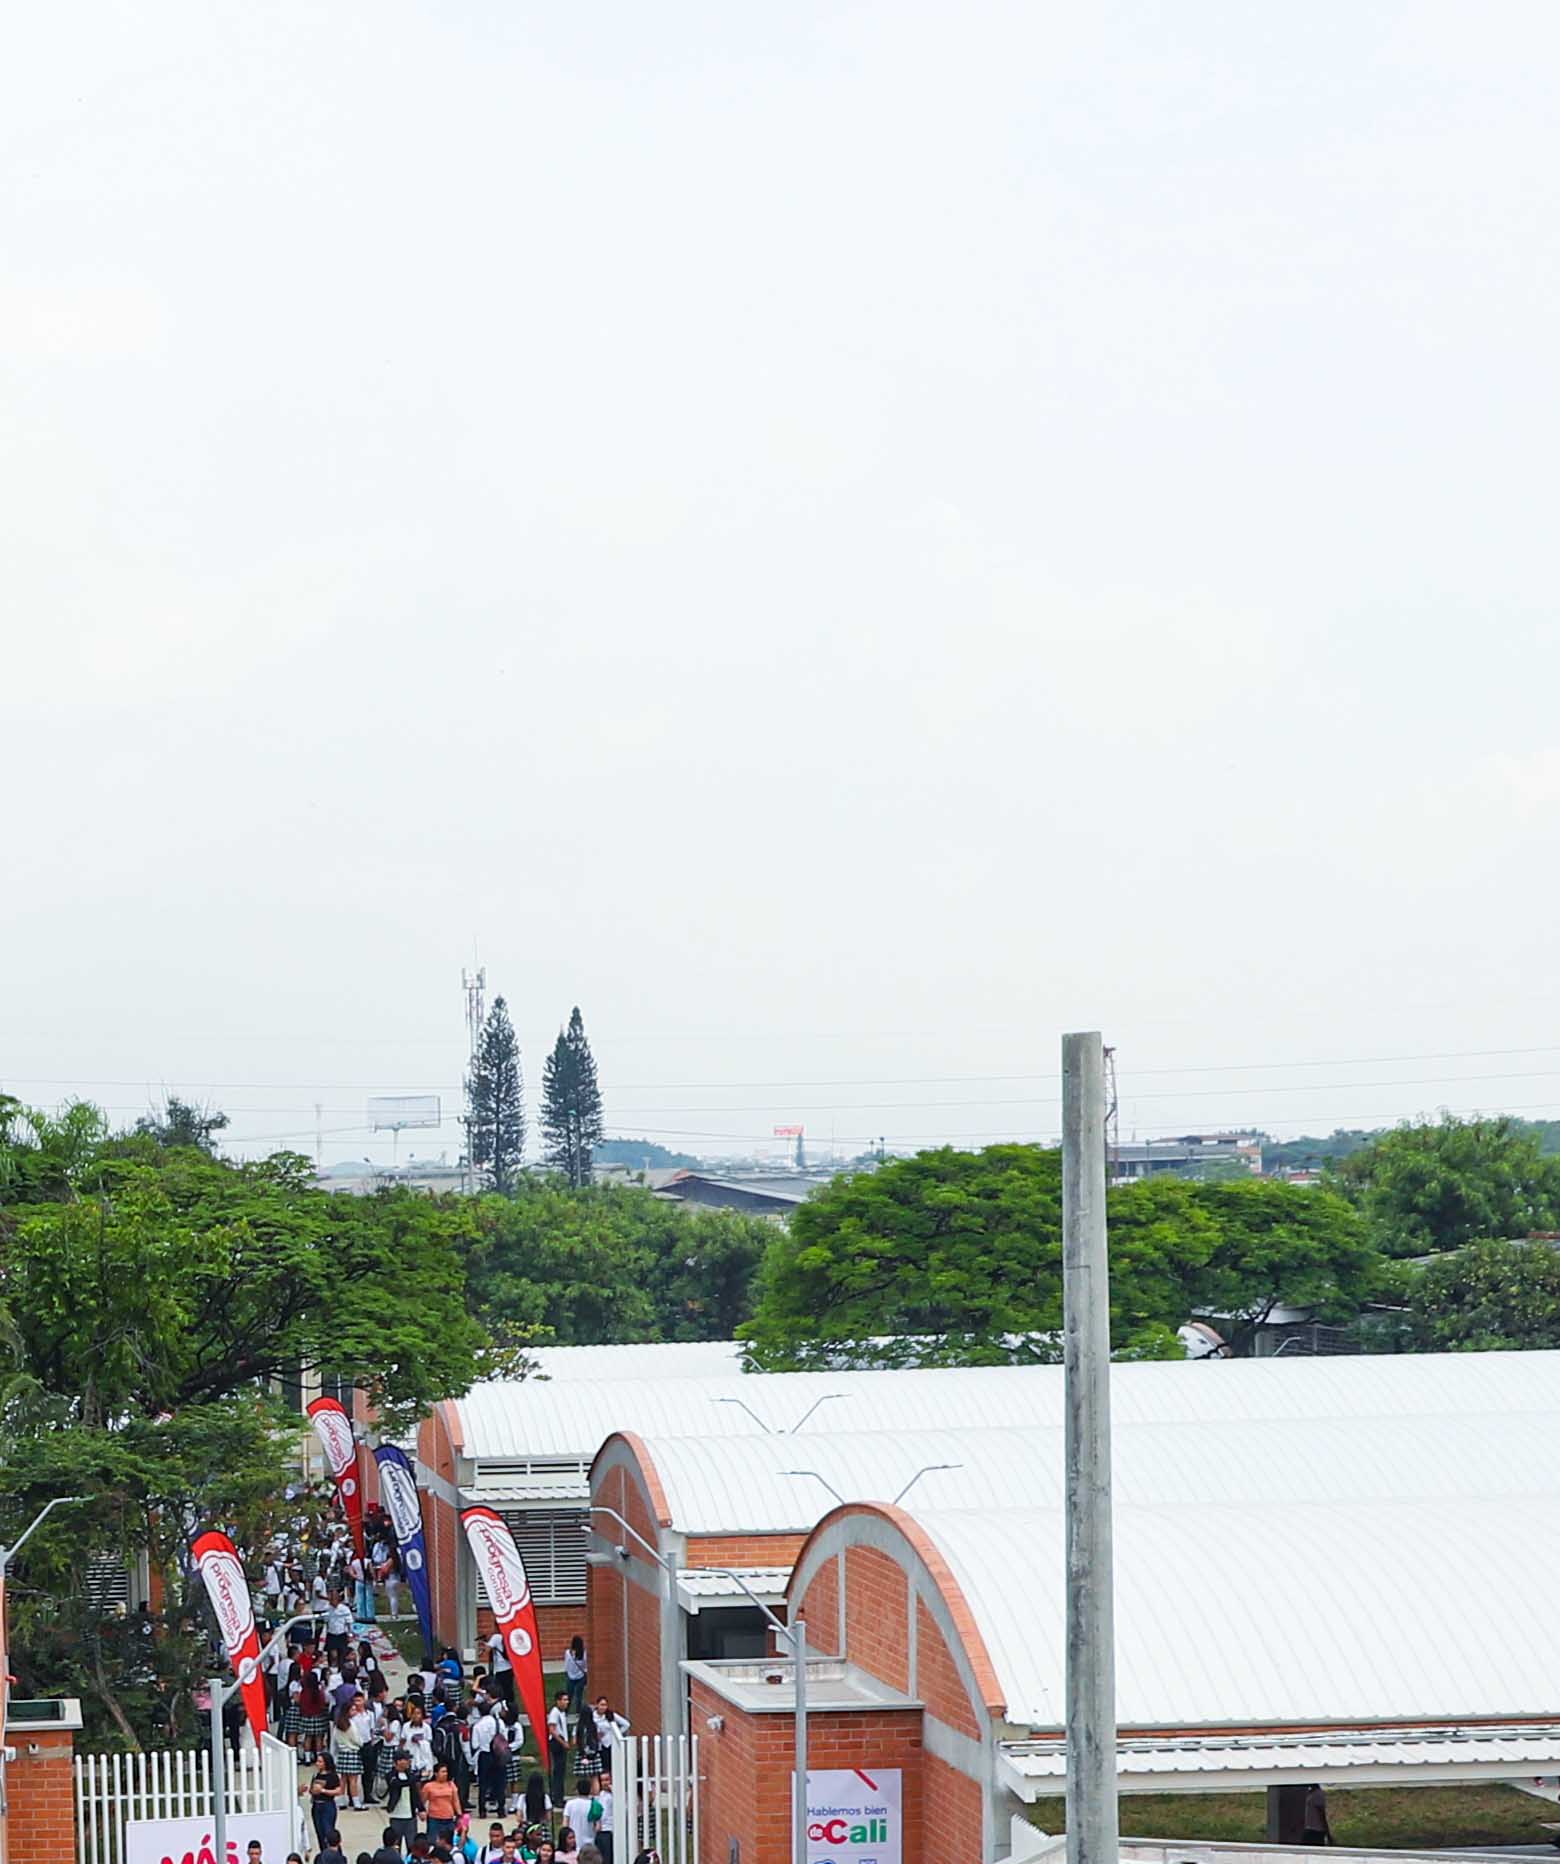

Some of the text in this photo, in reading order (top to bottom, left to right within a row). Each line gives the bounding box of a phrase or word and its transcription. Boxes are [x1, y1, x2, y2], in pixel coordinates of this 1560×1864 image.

[807, 1805, 888, 1816] Hablemos bien
[825, 1818, 888, 1845] Cali
